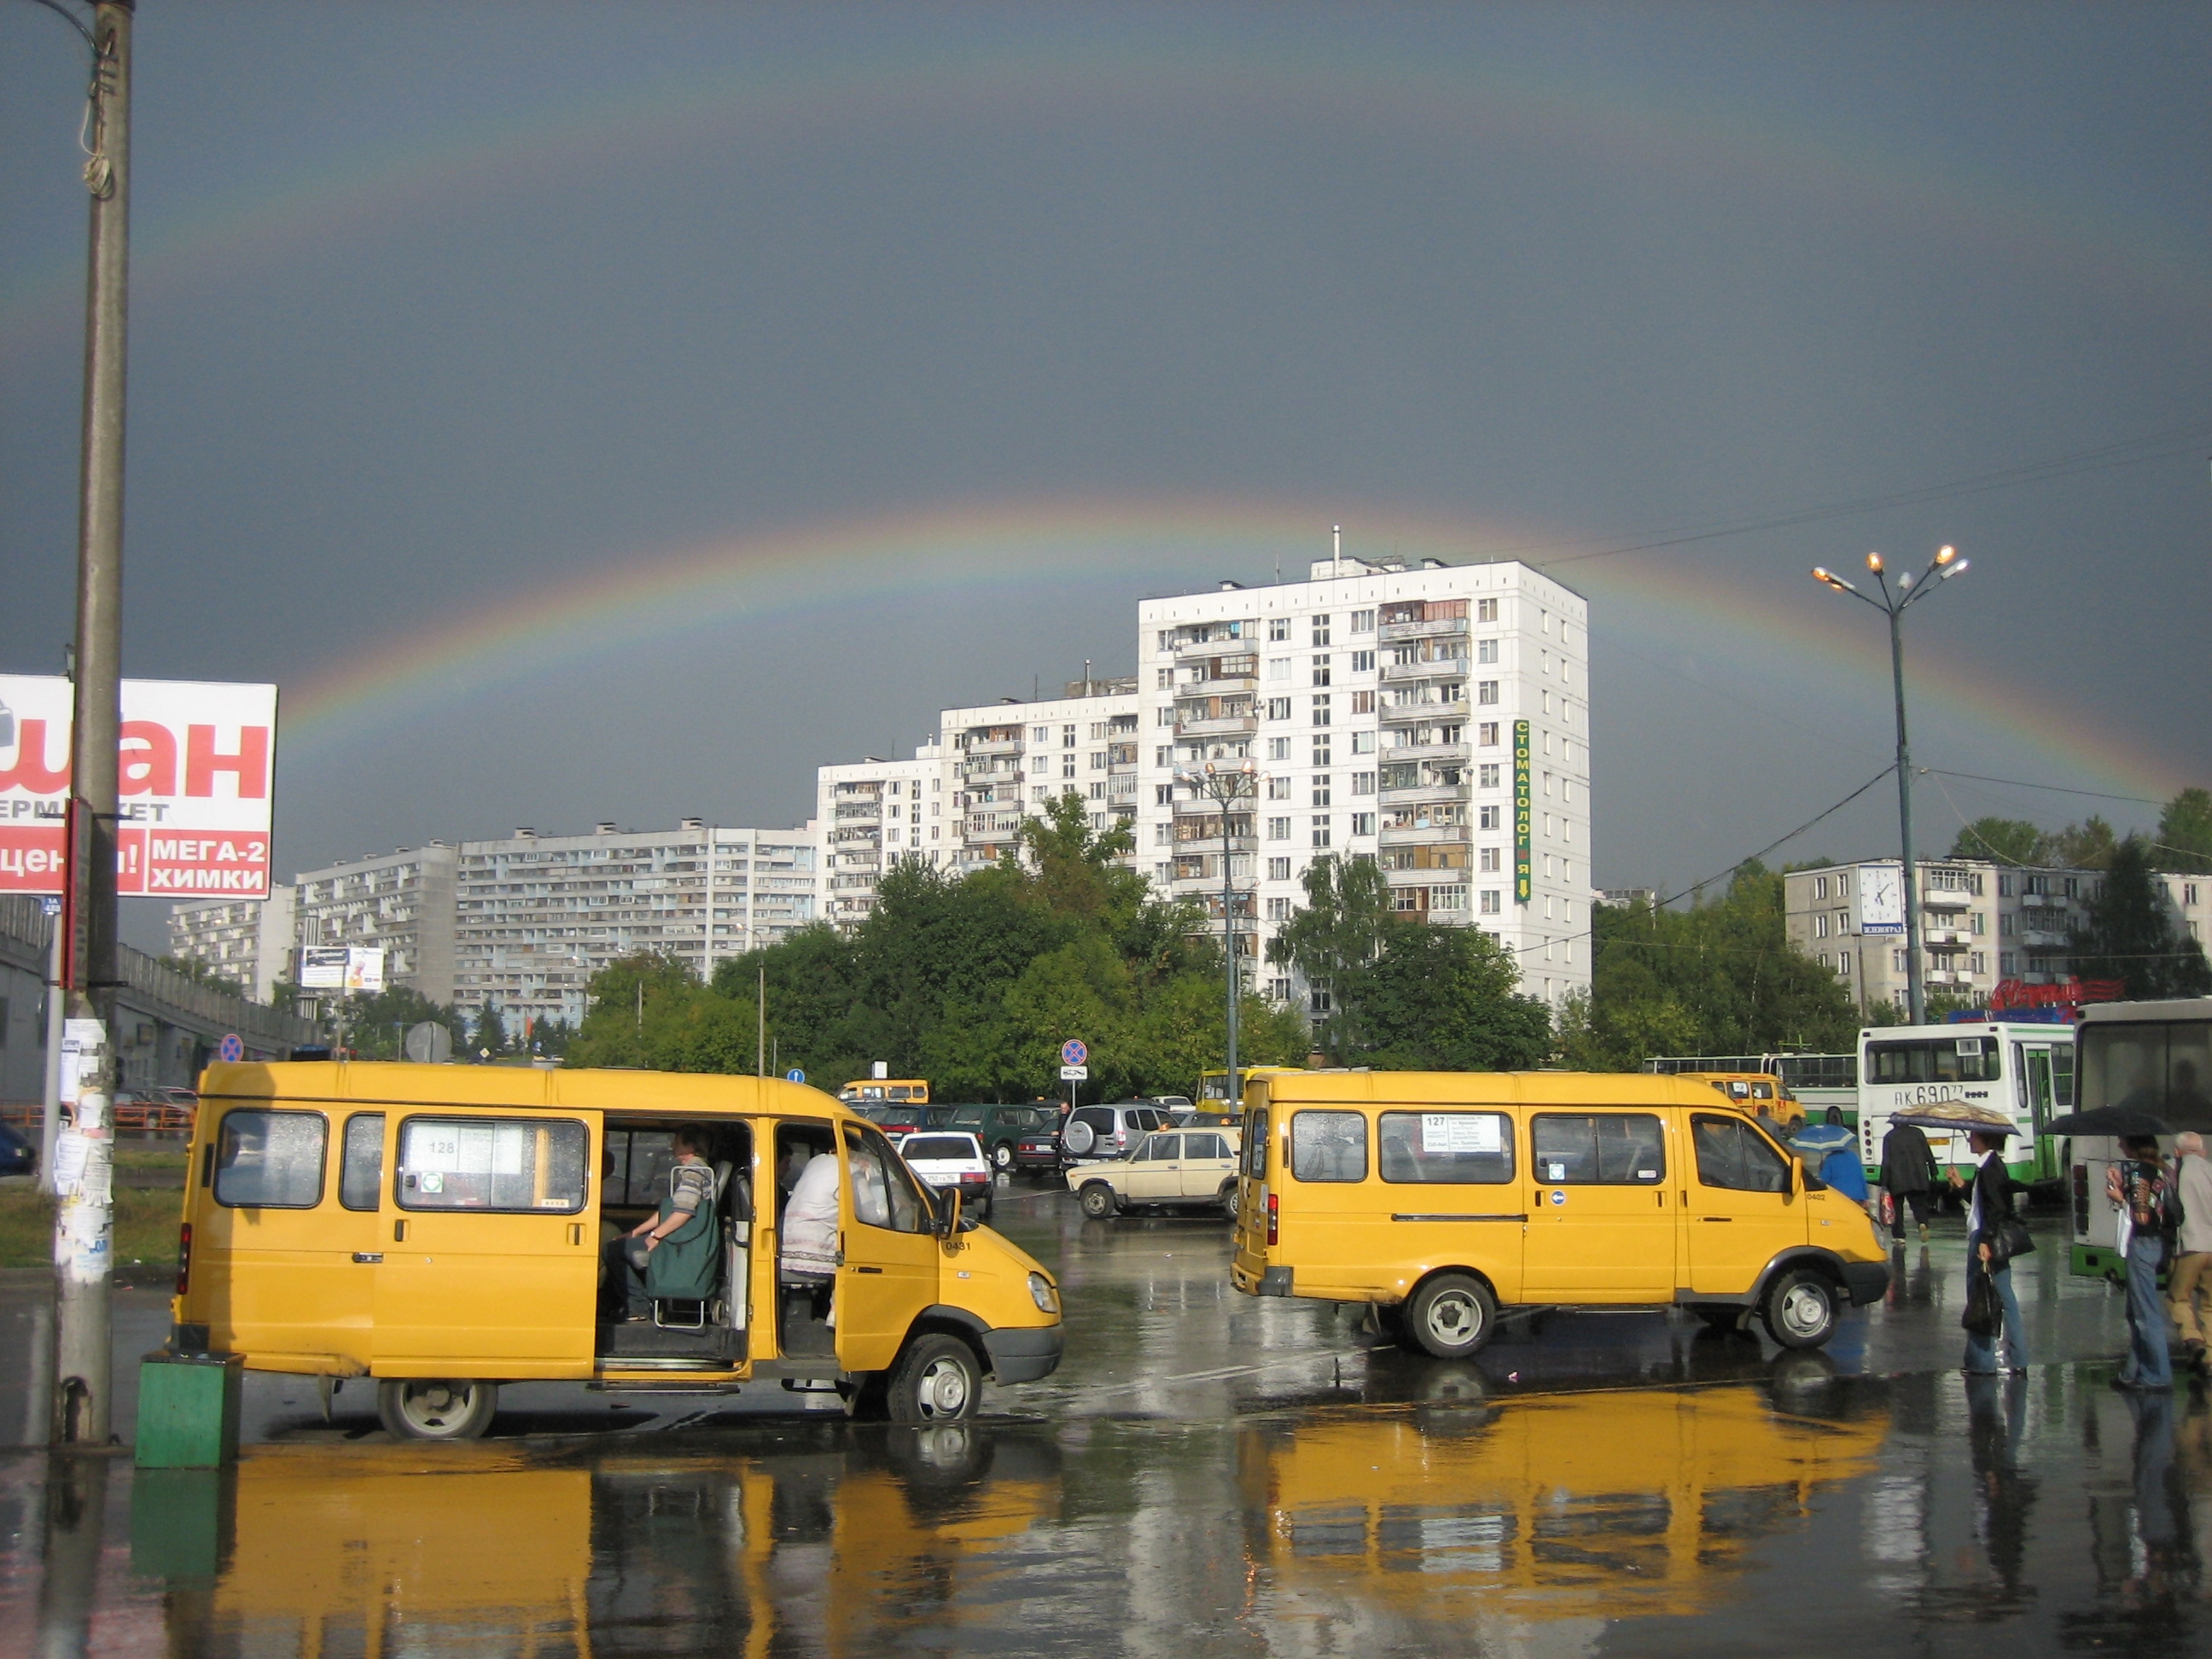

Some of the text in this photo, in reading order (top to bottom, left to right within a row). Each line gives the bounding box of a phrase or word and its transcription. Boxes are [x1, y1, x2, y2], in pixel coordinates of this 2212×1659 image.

[152, 839, 265, 863] МЕГА-2
[150, 868, 264, 890] ХИМКИ
[1916, 1086, 1950, 1105] 690
[1952, 1085, 1964, 1093] 77
[1427, 1116, 1446, 1126] 127
[429, 1142, 454, 1154] 128
